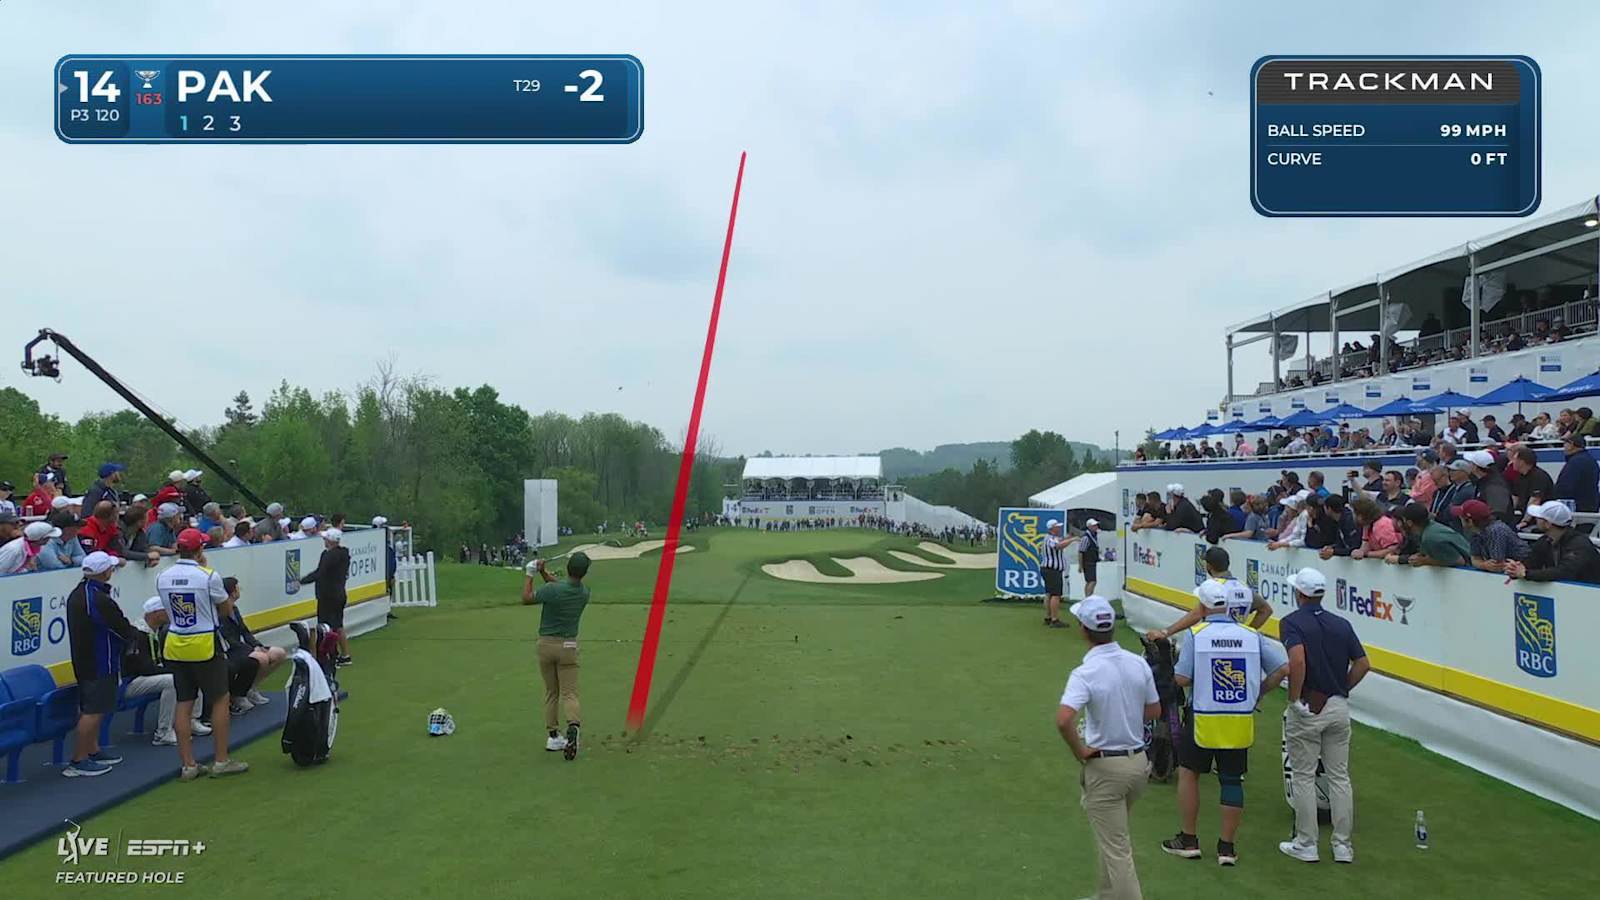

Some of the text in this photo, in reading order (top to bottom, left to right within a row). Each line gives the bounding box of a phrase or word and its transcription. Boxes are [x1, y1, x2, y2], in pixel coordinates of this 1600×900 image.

[350, 557, 377, 577] OPEN
[1004, 569, 1046, 589] RB
[1349, 585, 1394, 623] FedEx
[14, 636, 39, 654] RBC
[1211, 639, 1243, 649] MOUW
[1519, 648, 1554, 674] RBC
[1215, 689, 1245, 701] RBC
